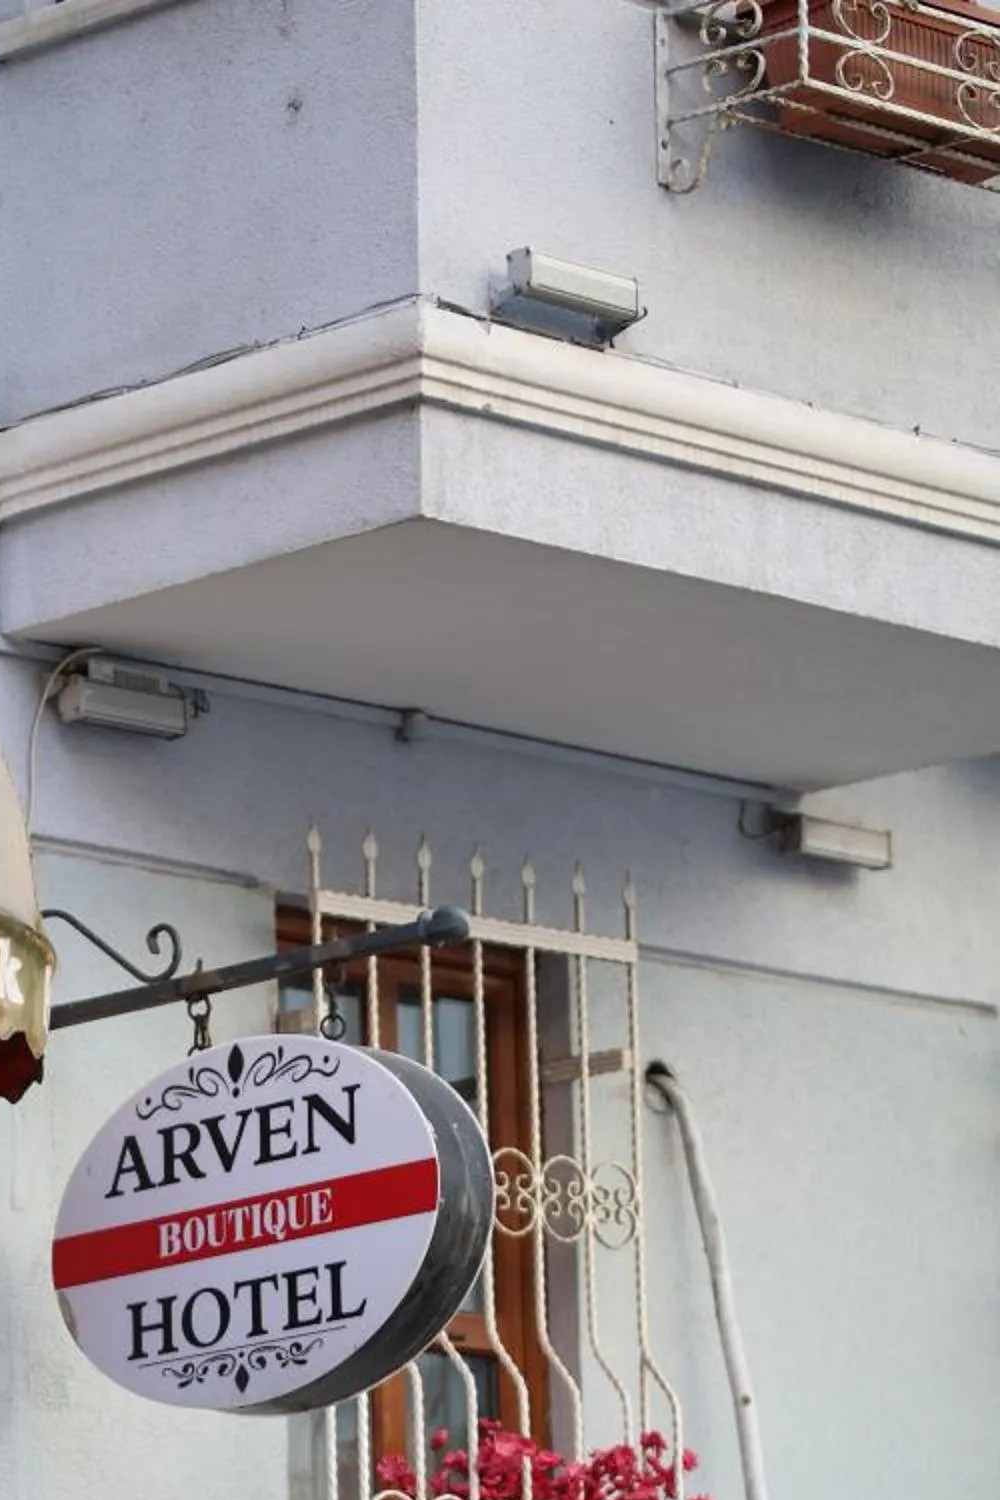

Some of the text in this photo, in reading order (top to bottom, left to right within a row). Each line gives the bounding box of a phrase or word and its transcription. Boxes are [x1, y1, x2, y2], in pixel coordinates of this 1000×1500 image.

[105, 1084, 361, 1198] ARVEN
[158, 1187, 333, 1259] BOUTIQUE
[126, 1260, 367, 1361] HOTEL
